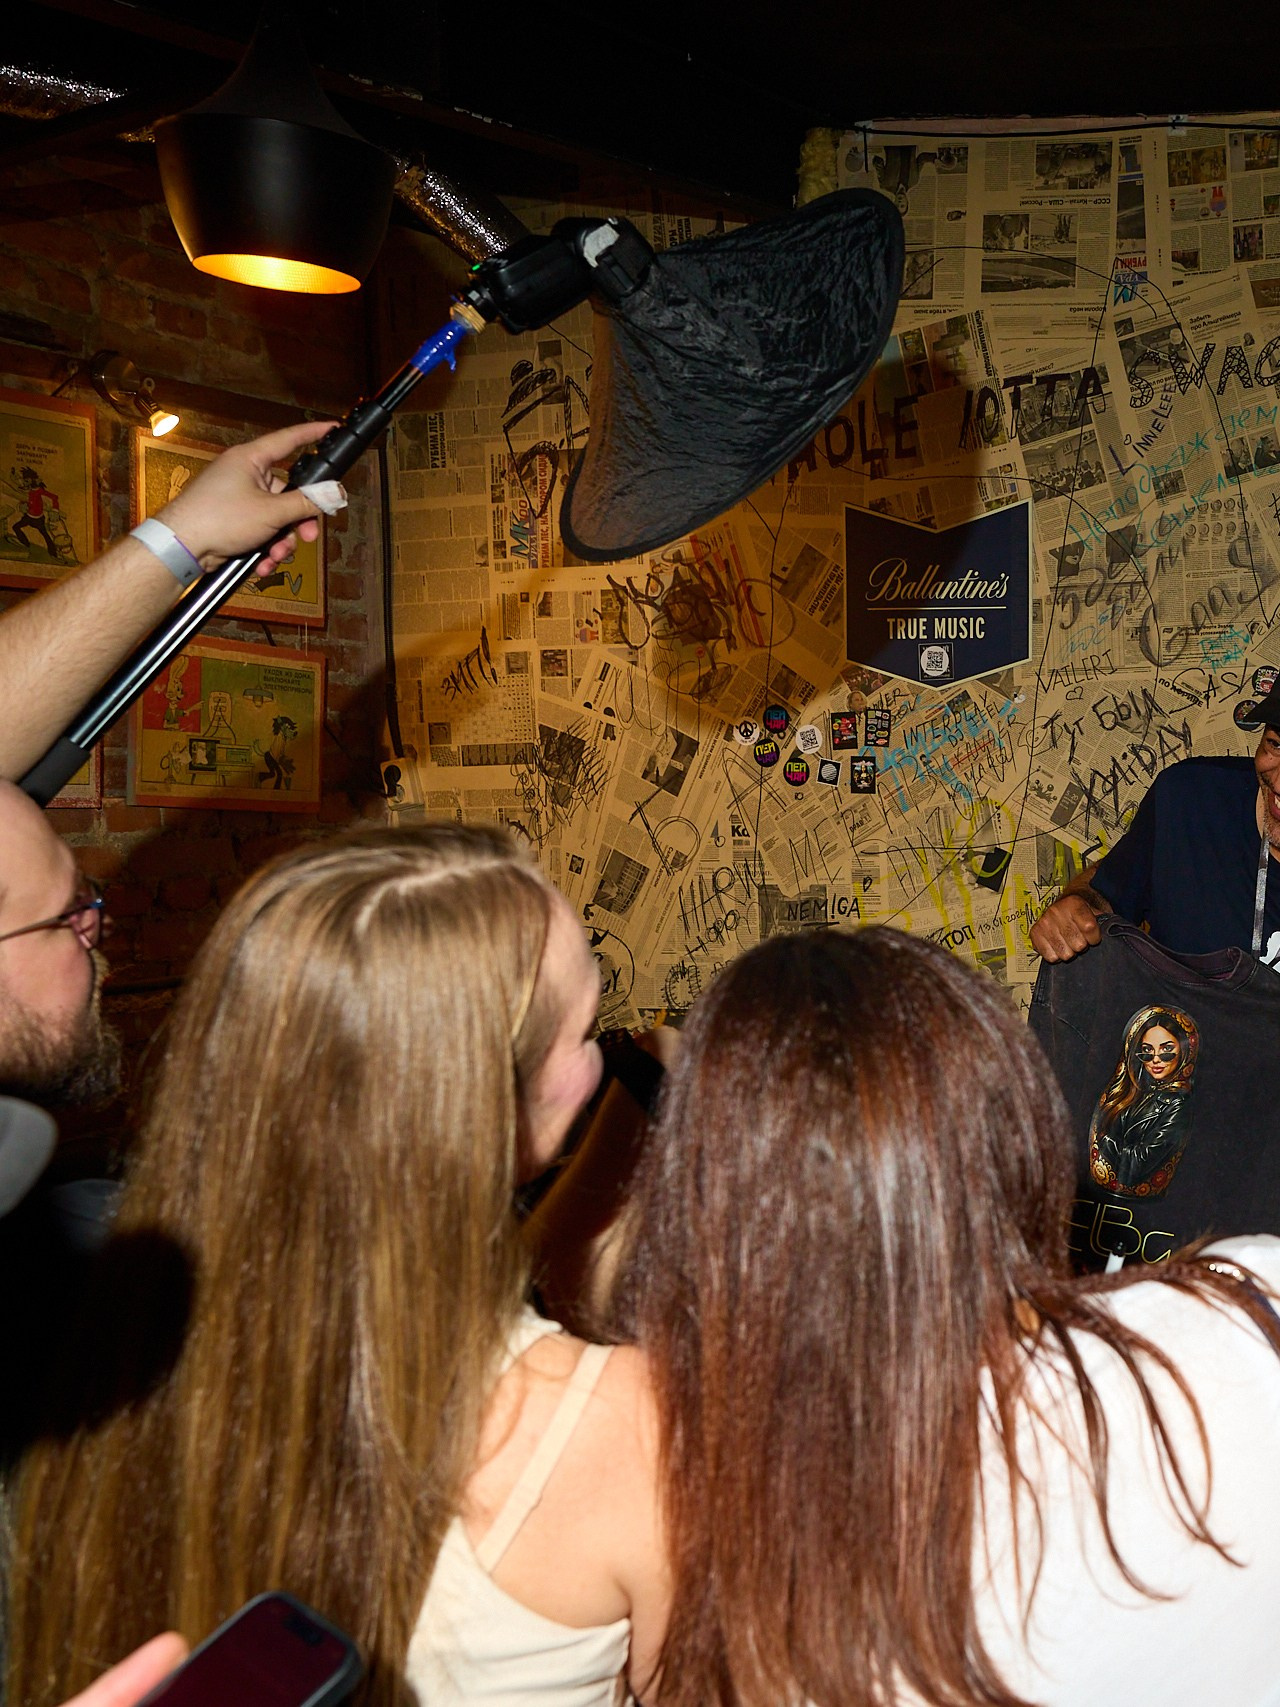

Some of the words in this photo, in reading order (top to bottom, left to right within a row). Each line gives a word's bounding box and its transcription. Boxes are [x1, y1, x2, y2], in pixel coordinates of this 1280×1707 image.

[429, 411, 440, 433] ЛЕС,
[430, 433, 440, 469] РУБИМ
[865, 557, 1010, 602] Ballantine's
[887, 617, 928, 640] TRUE
[934, 616, 986, 640] MUSIC
